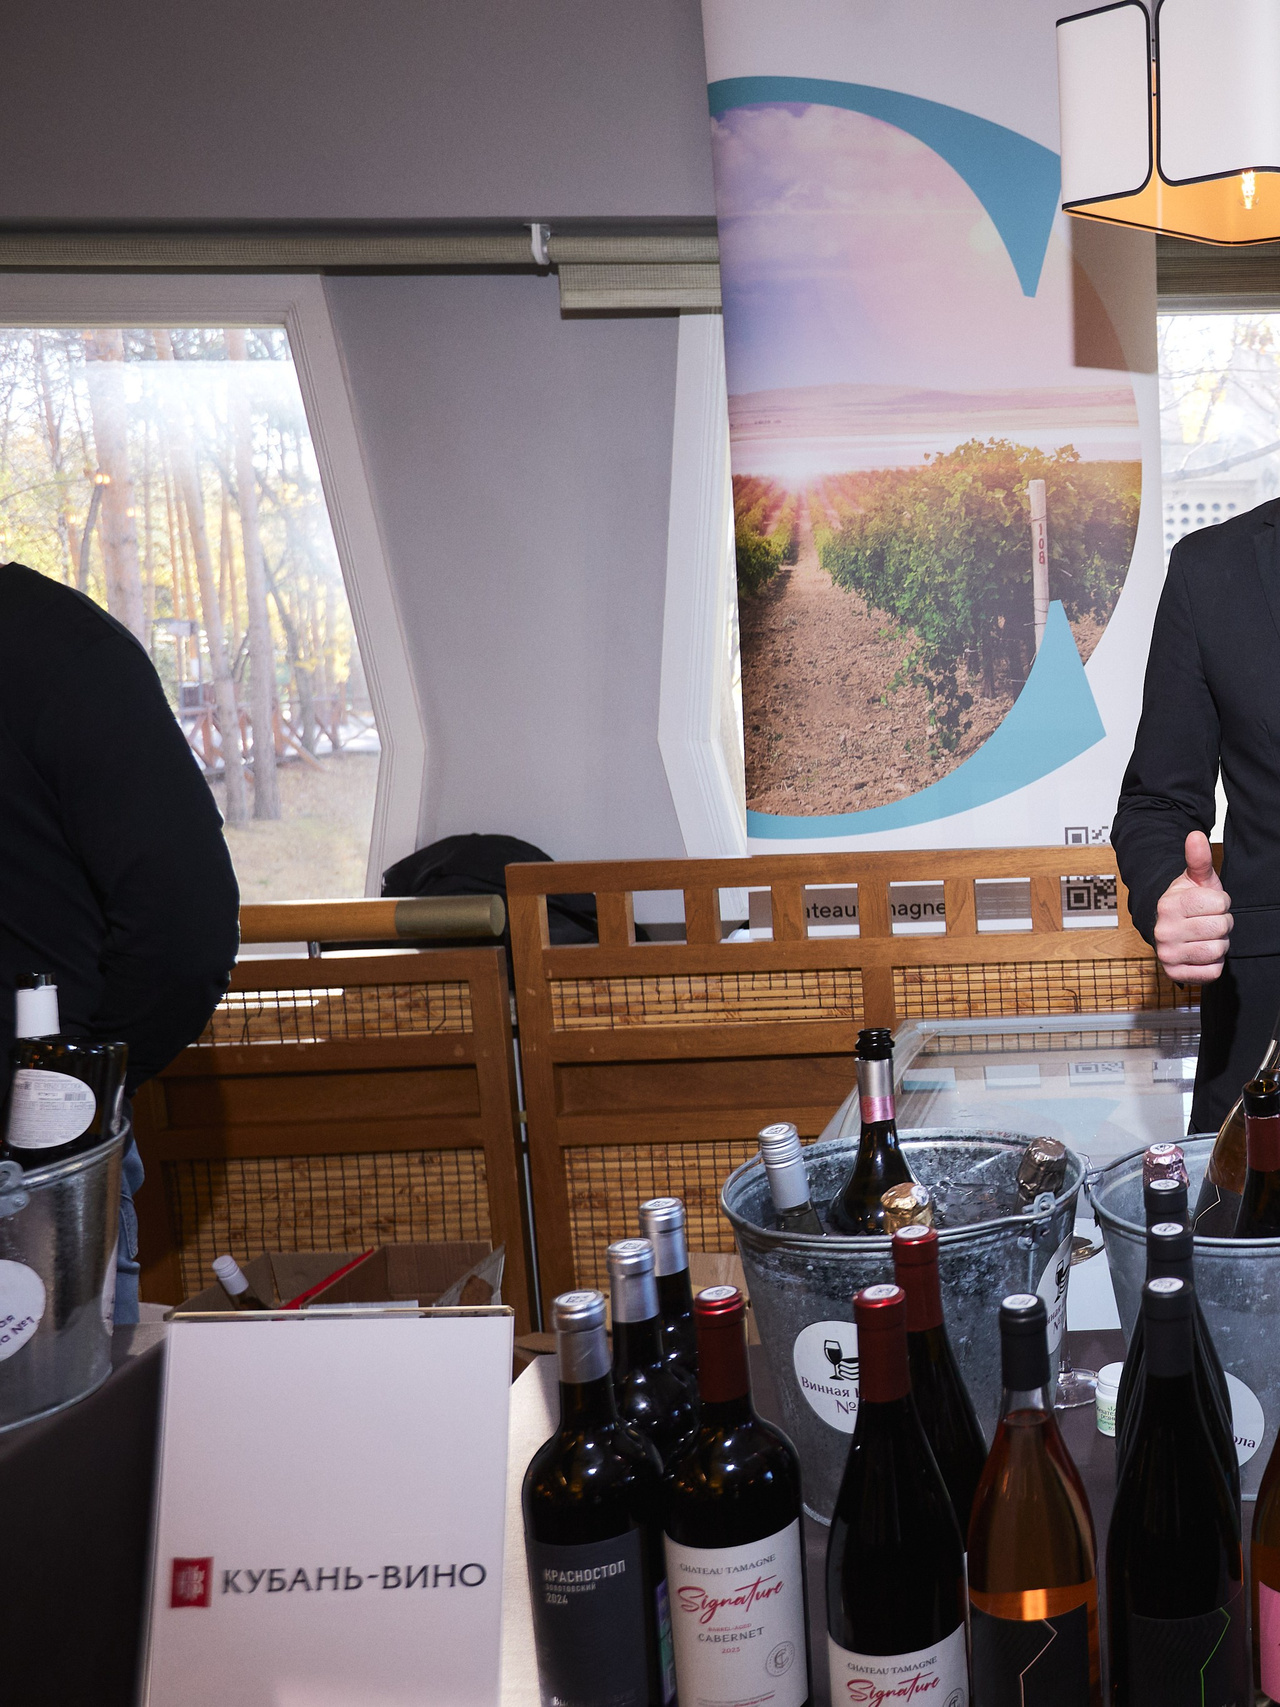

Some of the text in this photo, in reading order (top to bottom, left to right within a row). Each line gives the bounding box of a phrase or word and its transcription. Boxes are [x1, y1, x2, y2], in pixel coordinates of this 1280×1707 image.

[806, 902, 945, 920] teau agne
[11, 1315, 36, 1336] №1
[801, 1375, 850, 1398] Винная
[544, 1559, 626, 1583] КРАСНОСТОП
[680, 1553, 777, 1576] CHATEAU TAMAGNE
[221, 1562, 487, 1595] КУБАНЬ-ВИНО
[677, 1574, 785, 1625] Signature
[698, 1626, 765, 1644] CABERNET
[847, 1655, 938, 1675] CHATEAU TAMAGNE
[846, 1671, 941, 1707] Signature
